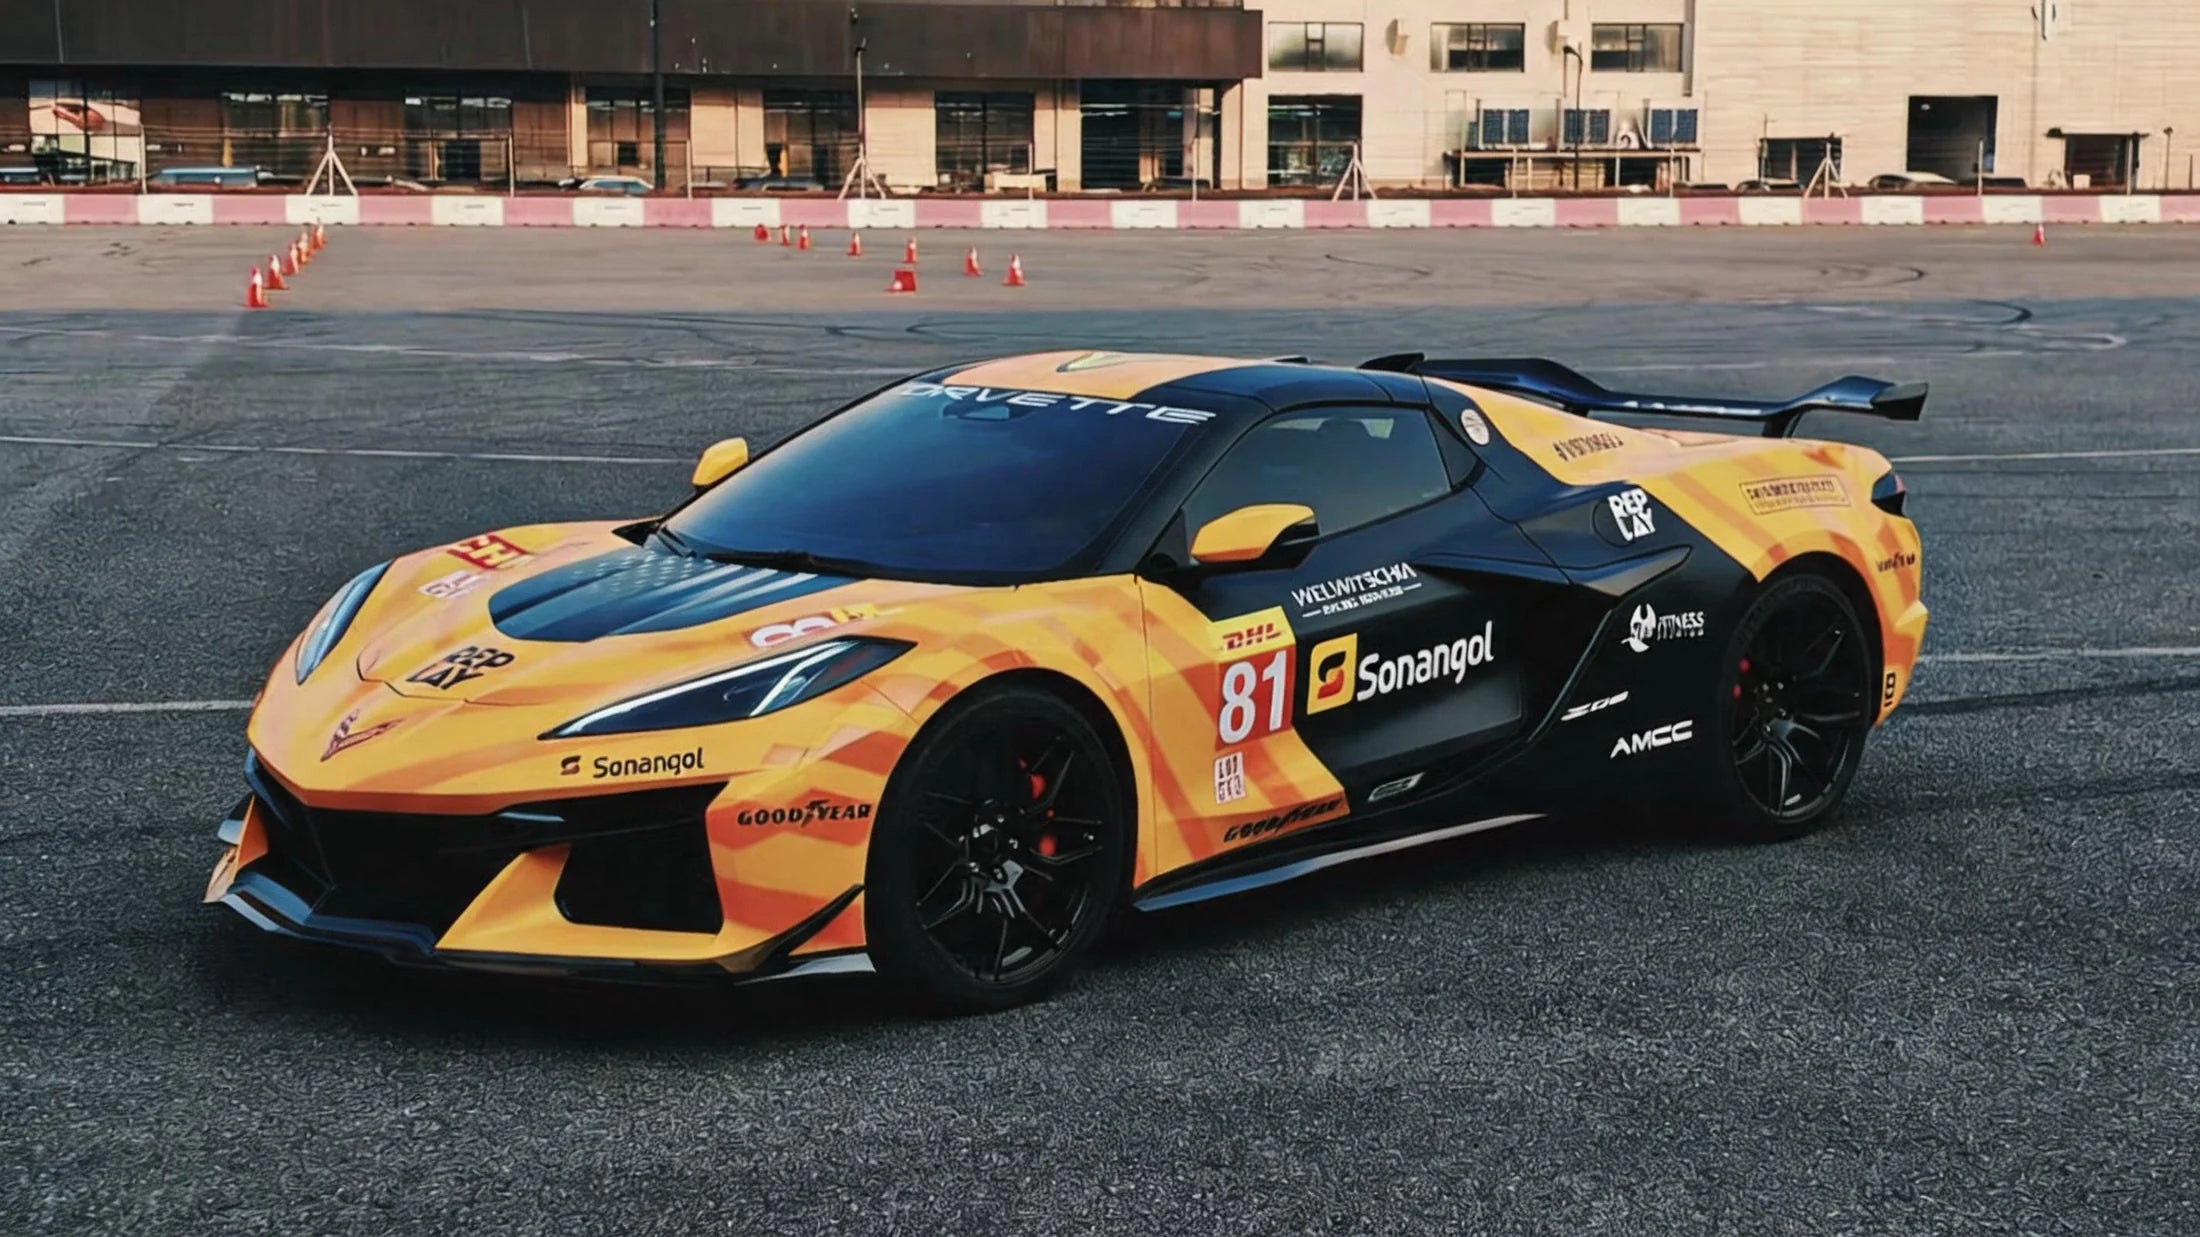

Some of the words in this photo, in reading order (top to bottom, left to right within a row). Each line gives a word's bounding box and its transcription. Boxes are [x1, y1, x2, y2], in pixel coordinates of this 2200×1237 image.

[1222, 623, 1284, 649] DHL
[1357, 620, 1494, 702] Sonangol
[1219, 651, 1287, 744] 81
[1610, 719, 1693, 759] AMCC
[593, 748, 705, 779] Sonangol
[737, 800, 872, 828] GOODYEAR
